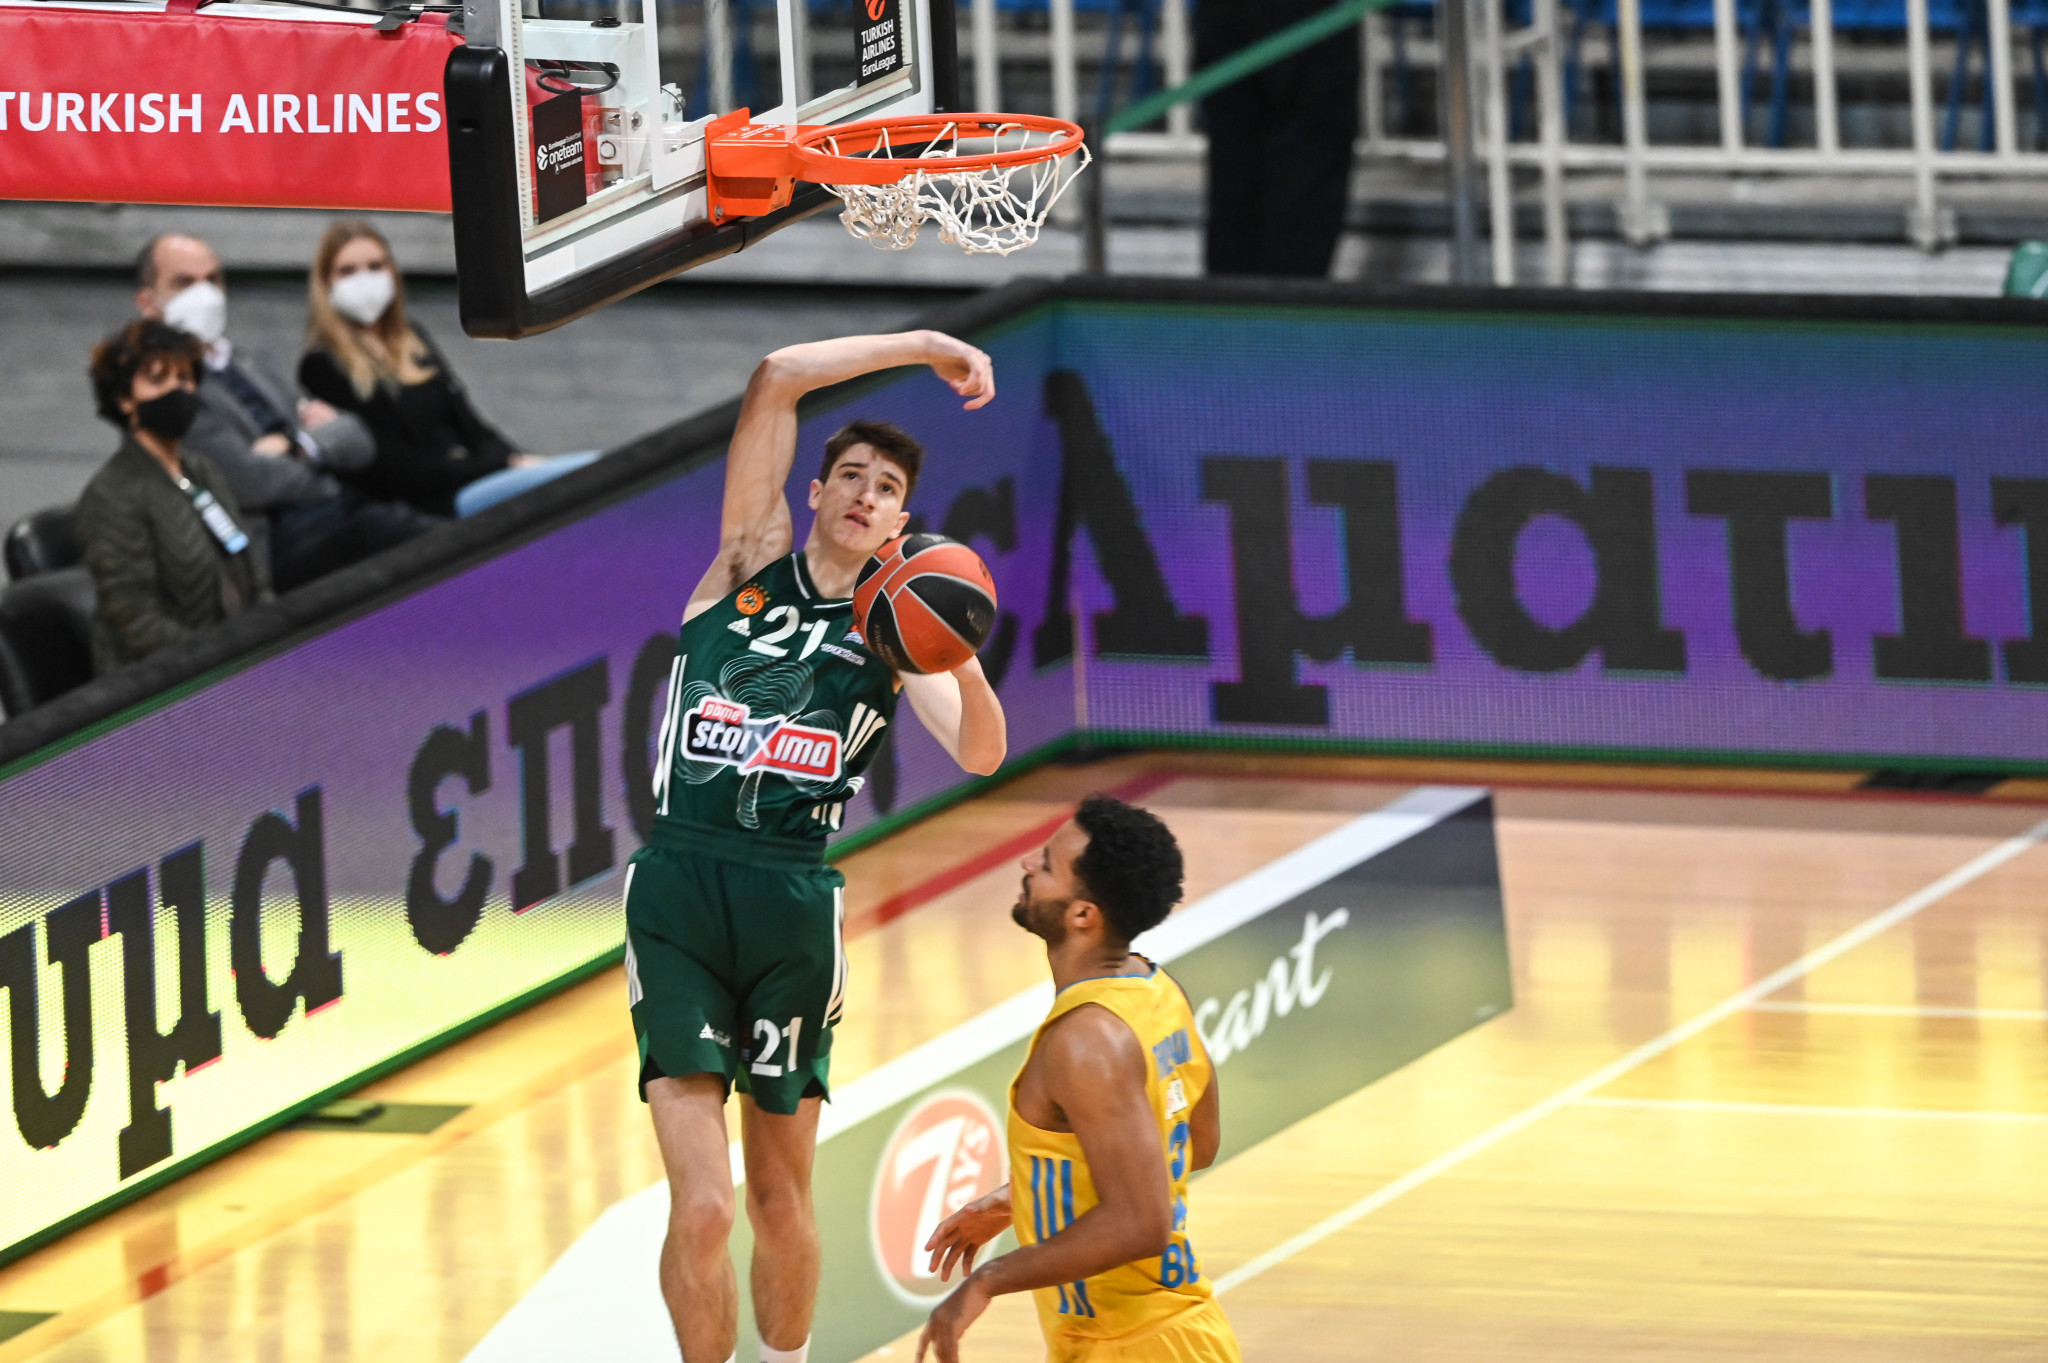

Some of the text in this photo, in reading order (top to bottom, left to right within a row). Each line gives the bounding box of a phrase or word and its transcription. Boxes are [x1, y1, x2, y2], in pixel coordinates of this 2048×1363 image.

[861, 19, 894, 45] TURKISH
[862, 35, 896, 62] AIRLINES
[862, 54, 897, 77] EuroLeague
[0, 91, 442, 133] TURKISH AIRLINES
[549, 140, 583, 165] oneteam
[748, 605, 831, 661] 21
[751, 1017, 803, 1077] 21
[895, 1114, 967, 1279] 7
